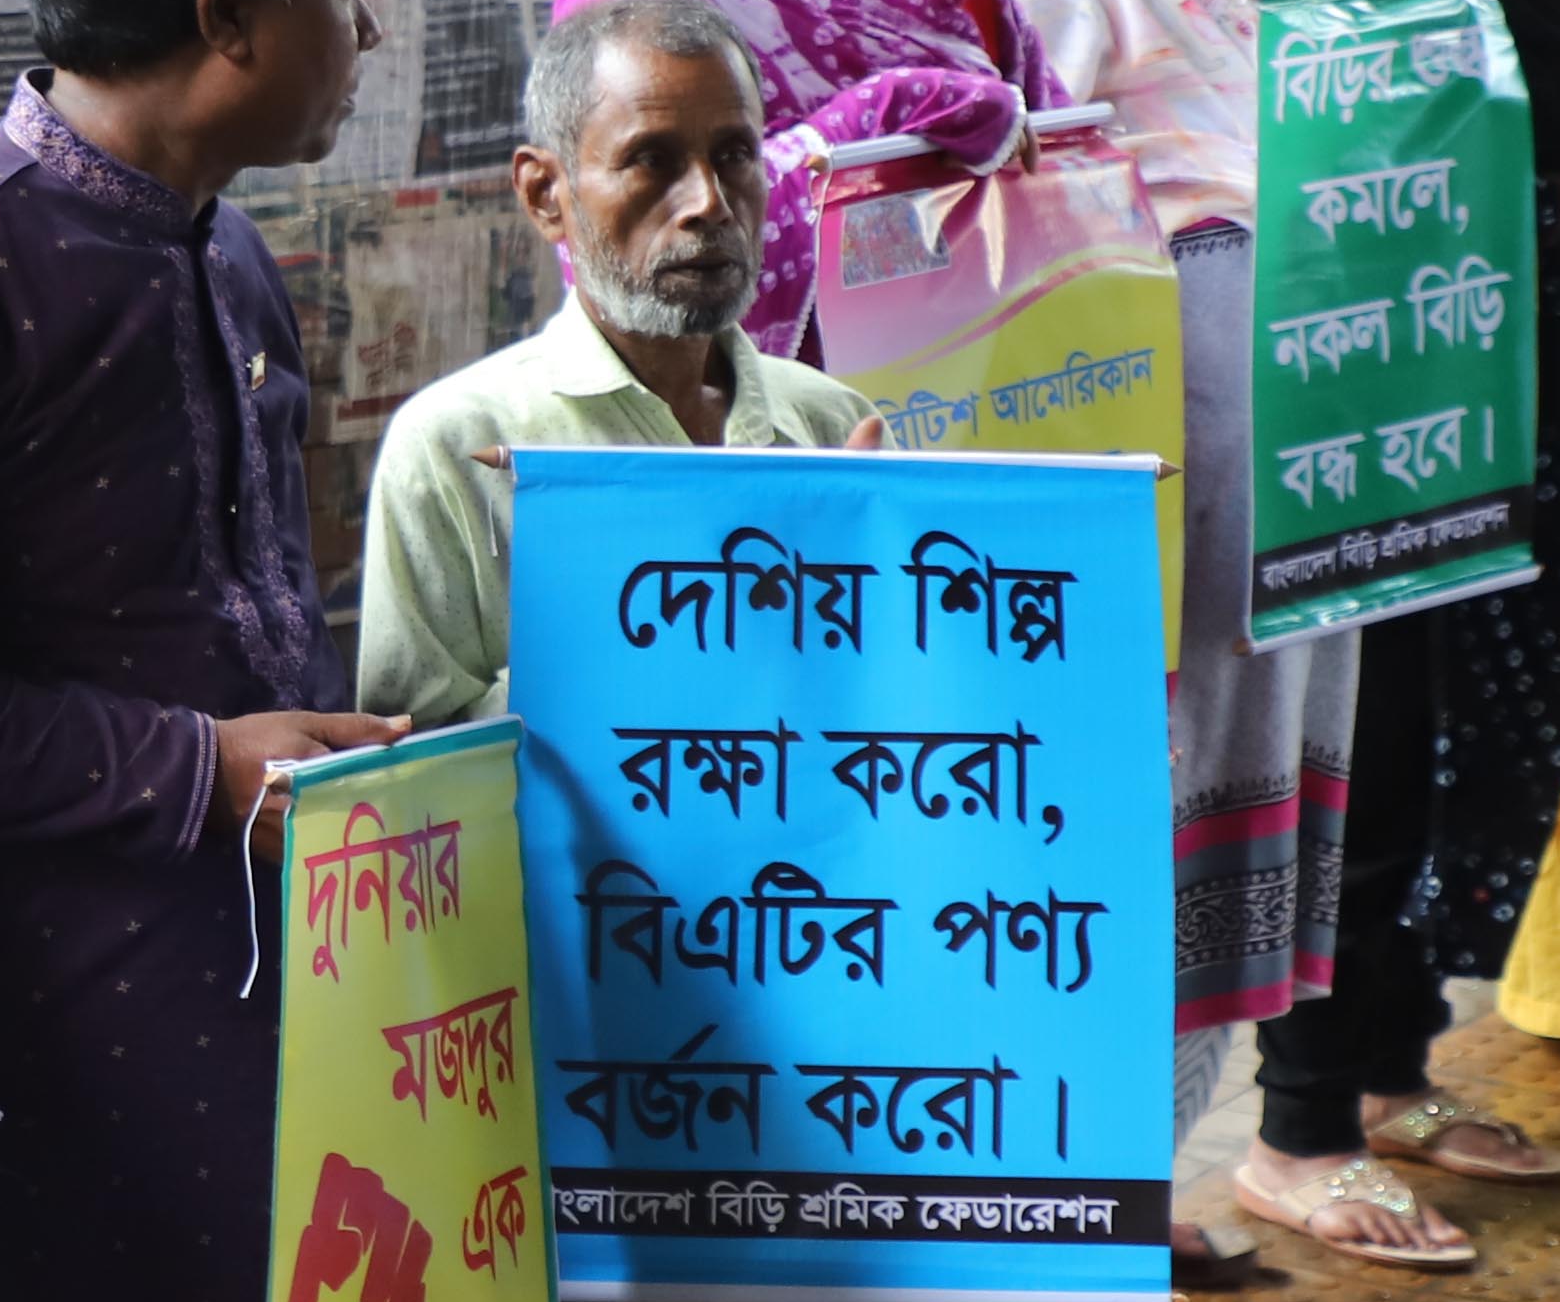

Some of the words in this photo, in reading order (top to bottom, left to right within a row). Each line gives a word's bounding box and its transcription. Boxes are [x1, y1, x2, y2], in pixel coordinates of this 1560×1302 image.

[1268, 30, 1400, 124] বিড়ির
[1301, 155, 1470, 244] কমলে,
[1268, 299, 1394, 384] নকল
[1405, 254, 1512, 352] বিড়ি
[990, 349, 1156, 425] আমেরিকান
[1277, 431, 1366, 510] বন্ধ
[619, 526, 878, 654] দেশিয়
[904, 529, 1078, 663] শিল্প
[1338, 528, 1378, 571] বিড়ি
[614, 717, 801, 823] রক্ষা
[821, 719, 1065, 845] করো,
[304, 800, 462, 983] দুনিয়ার
[575, 858, 898, 991] বিএটির
[935, 888, 1111, 993] পণ্য
[381, 985, 518, 1124] মজদুর
[556, 1024, 777, 1157] বর্জন
[461, 1165, 528, 1285] এক
[552, 1180, 695, 1230] াংলাদেশ
[706, 1184, 789, 1237] বিড়ি
[798, 1187, 905, 1230] শ্রমিক
[918, 1194, 1119, 1237] ফেডারেশন
